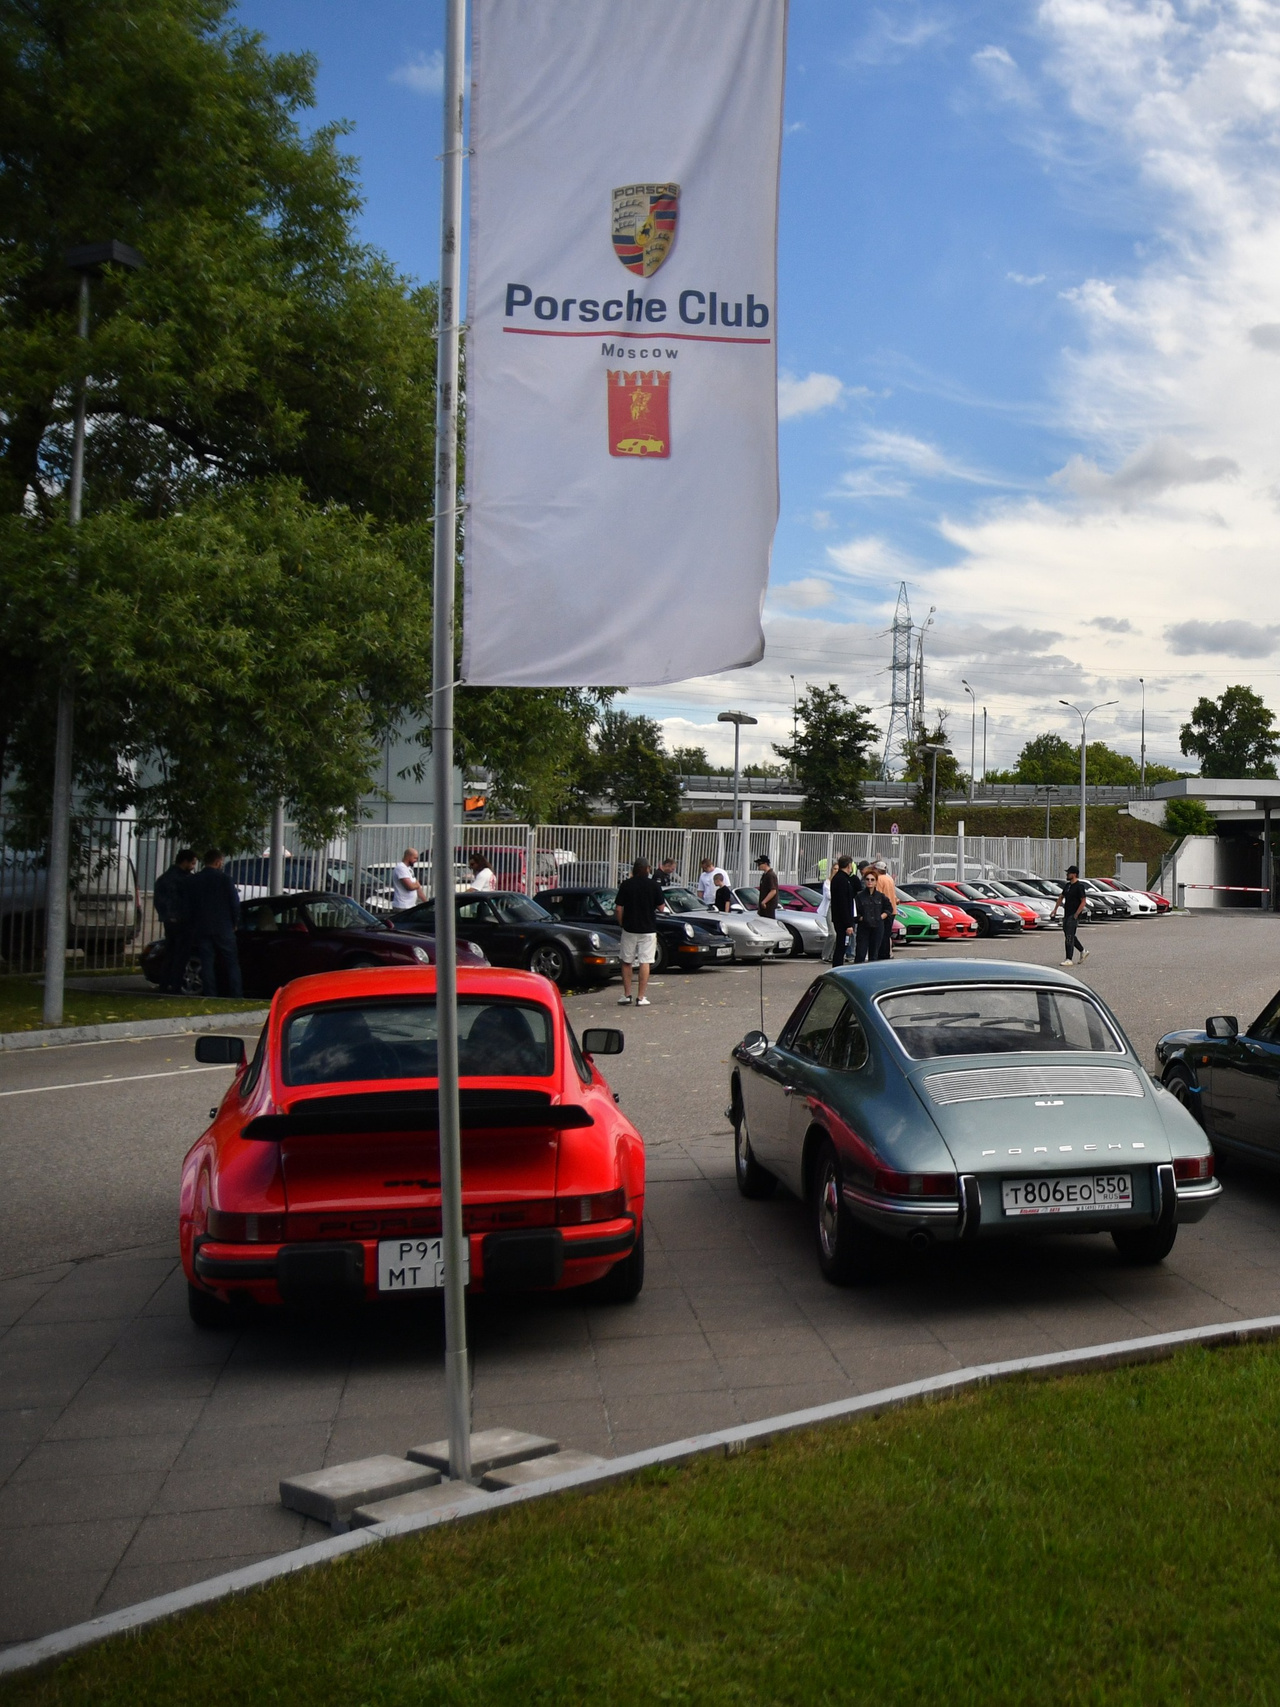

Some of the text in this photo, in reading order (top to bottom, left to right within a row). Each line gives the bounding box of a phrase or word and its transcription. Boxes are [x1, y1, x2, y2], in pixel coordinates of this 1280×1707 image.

[505, 283, 770, 327] Porsche Club
[601, 343, 678, 359] Moscow
[982, 1142, 1145, 1156] PORSCHE
[1096, 1177, 1127, 1193] 550
[318, 1209, 526, 1233] PORSHE
[400, 1241, 442, 1261] Р91
